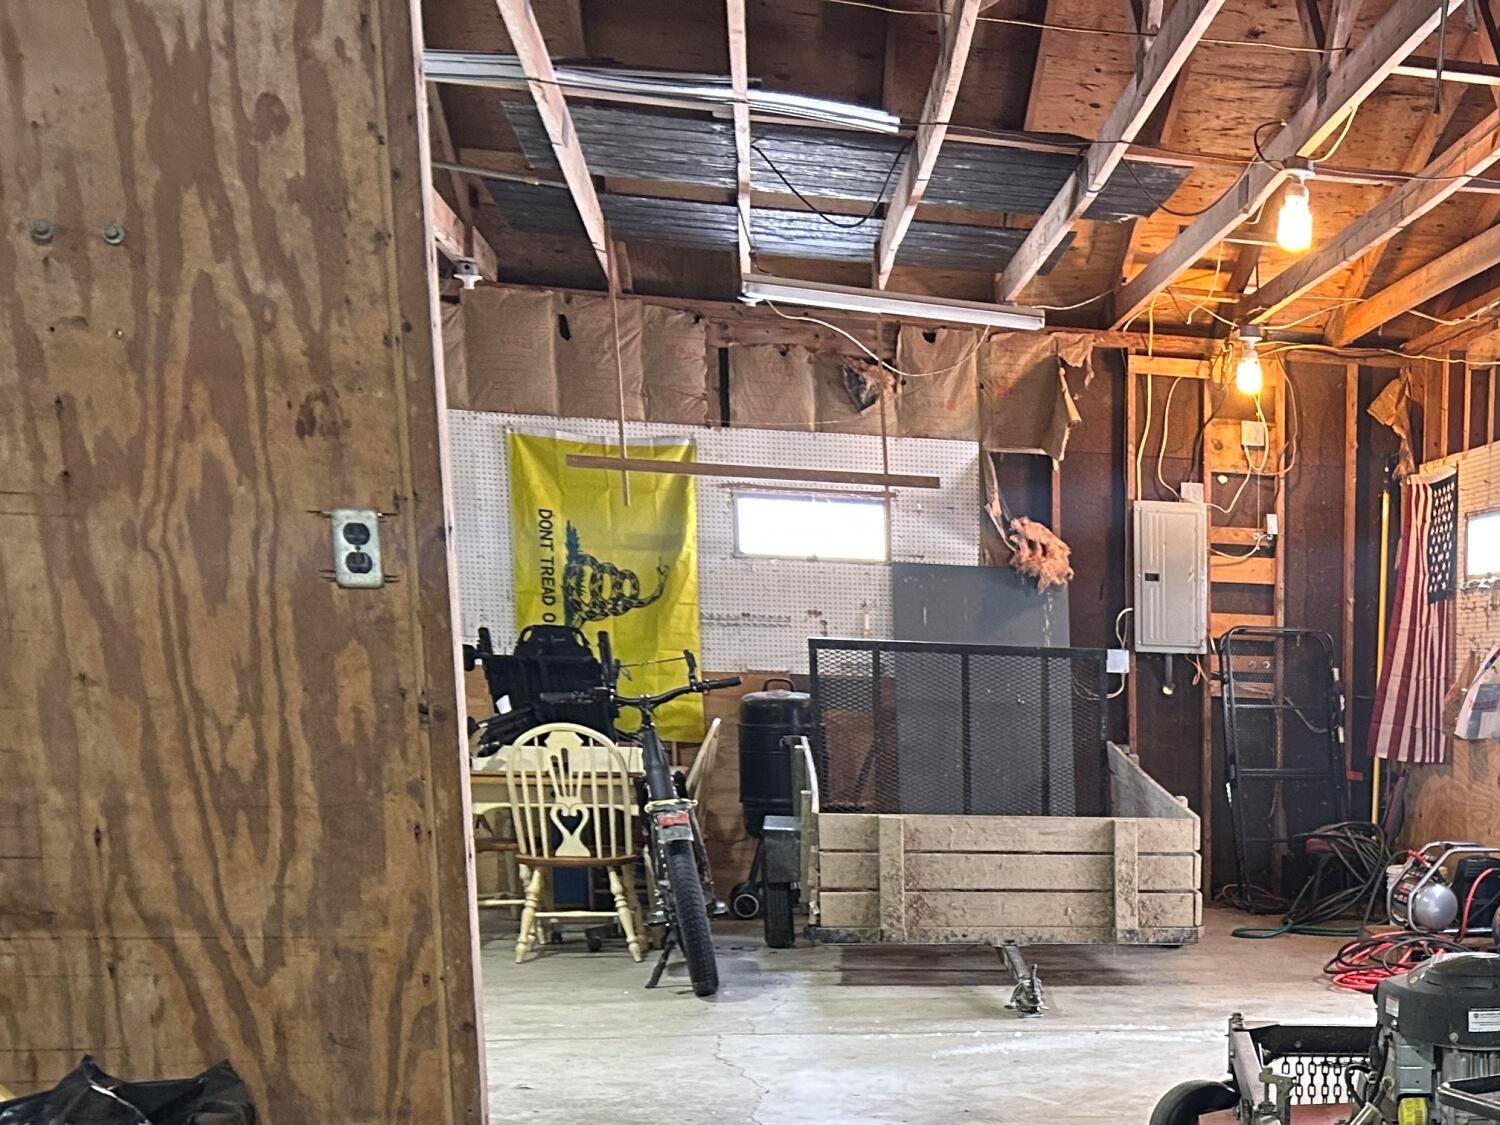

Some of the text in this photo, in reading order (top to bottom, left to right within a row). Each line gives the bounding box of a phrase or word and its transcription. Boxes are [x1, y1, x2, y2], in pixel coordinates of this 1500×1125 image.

[538, 508, 557, 623] DONT TREAD O
